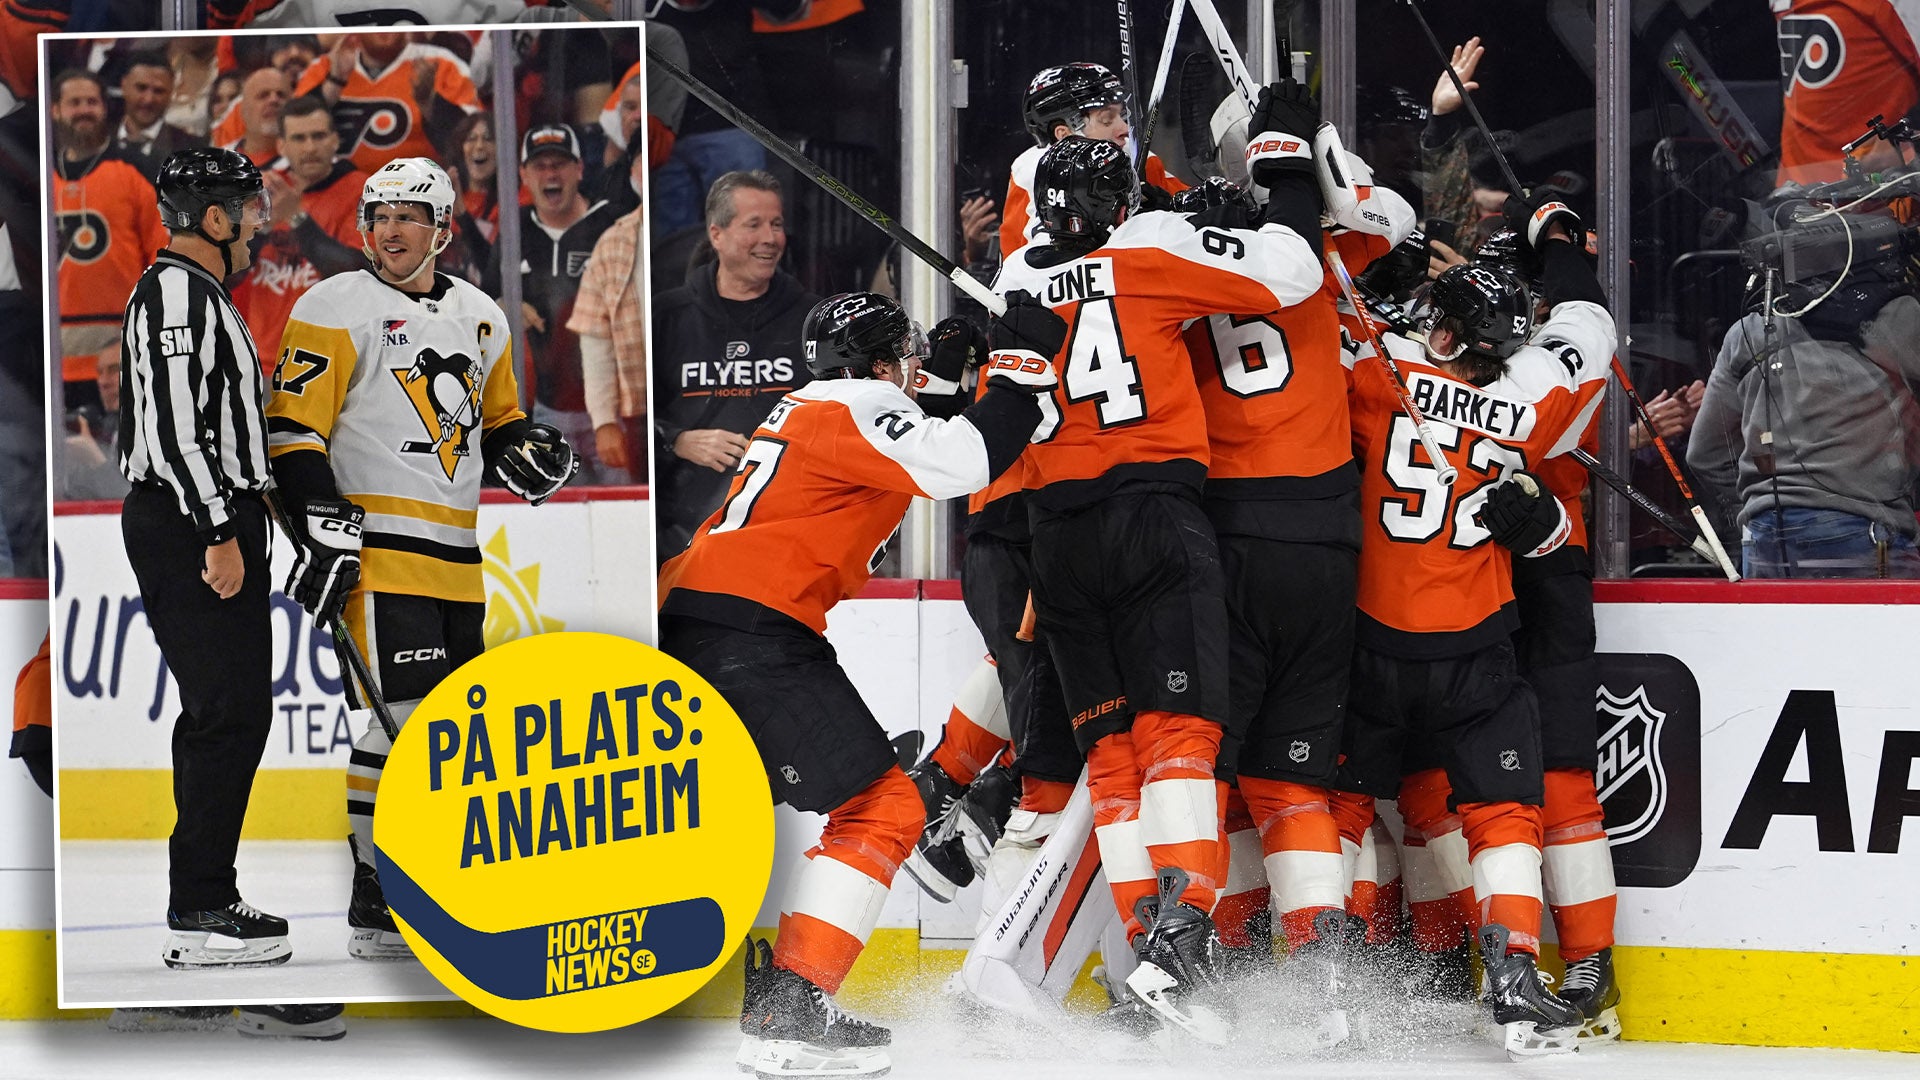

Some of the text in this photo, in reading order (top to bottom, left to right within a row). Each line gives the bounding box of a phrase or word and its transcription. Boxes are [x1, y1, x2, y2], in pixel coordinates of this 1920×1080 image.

[1117, 0, 1130, 57] BAUE
[1246, 140, 1301, 161] BAU
[1047, 188, 1066, 207] 94
[1361, 209, 1391, 227] BAUER
[1512, 315, 1527, 335] 52
[159, 327, 194, 357] SM
[806, 340, 817, 360] 27
[681, 357, 794, 388] FLYERS
[1413, 378, 1527, 437] BARKEY
[1379, 410, 1528, 550] 52
[306, 505, 340, 514] PENGUINS
[350, 512, 362, 523] 87
[320, 518, 363, 540] CC
[393, 647, 447, 665] CCM
[1071, 695, 1128, 731] BAUER
[279, 703, 353, 754] TEA
[994, 854, 1048, 943] SUPREME
[1018, 861, 1069, 950] BAUER
